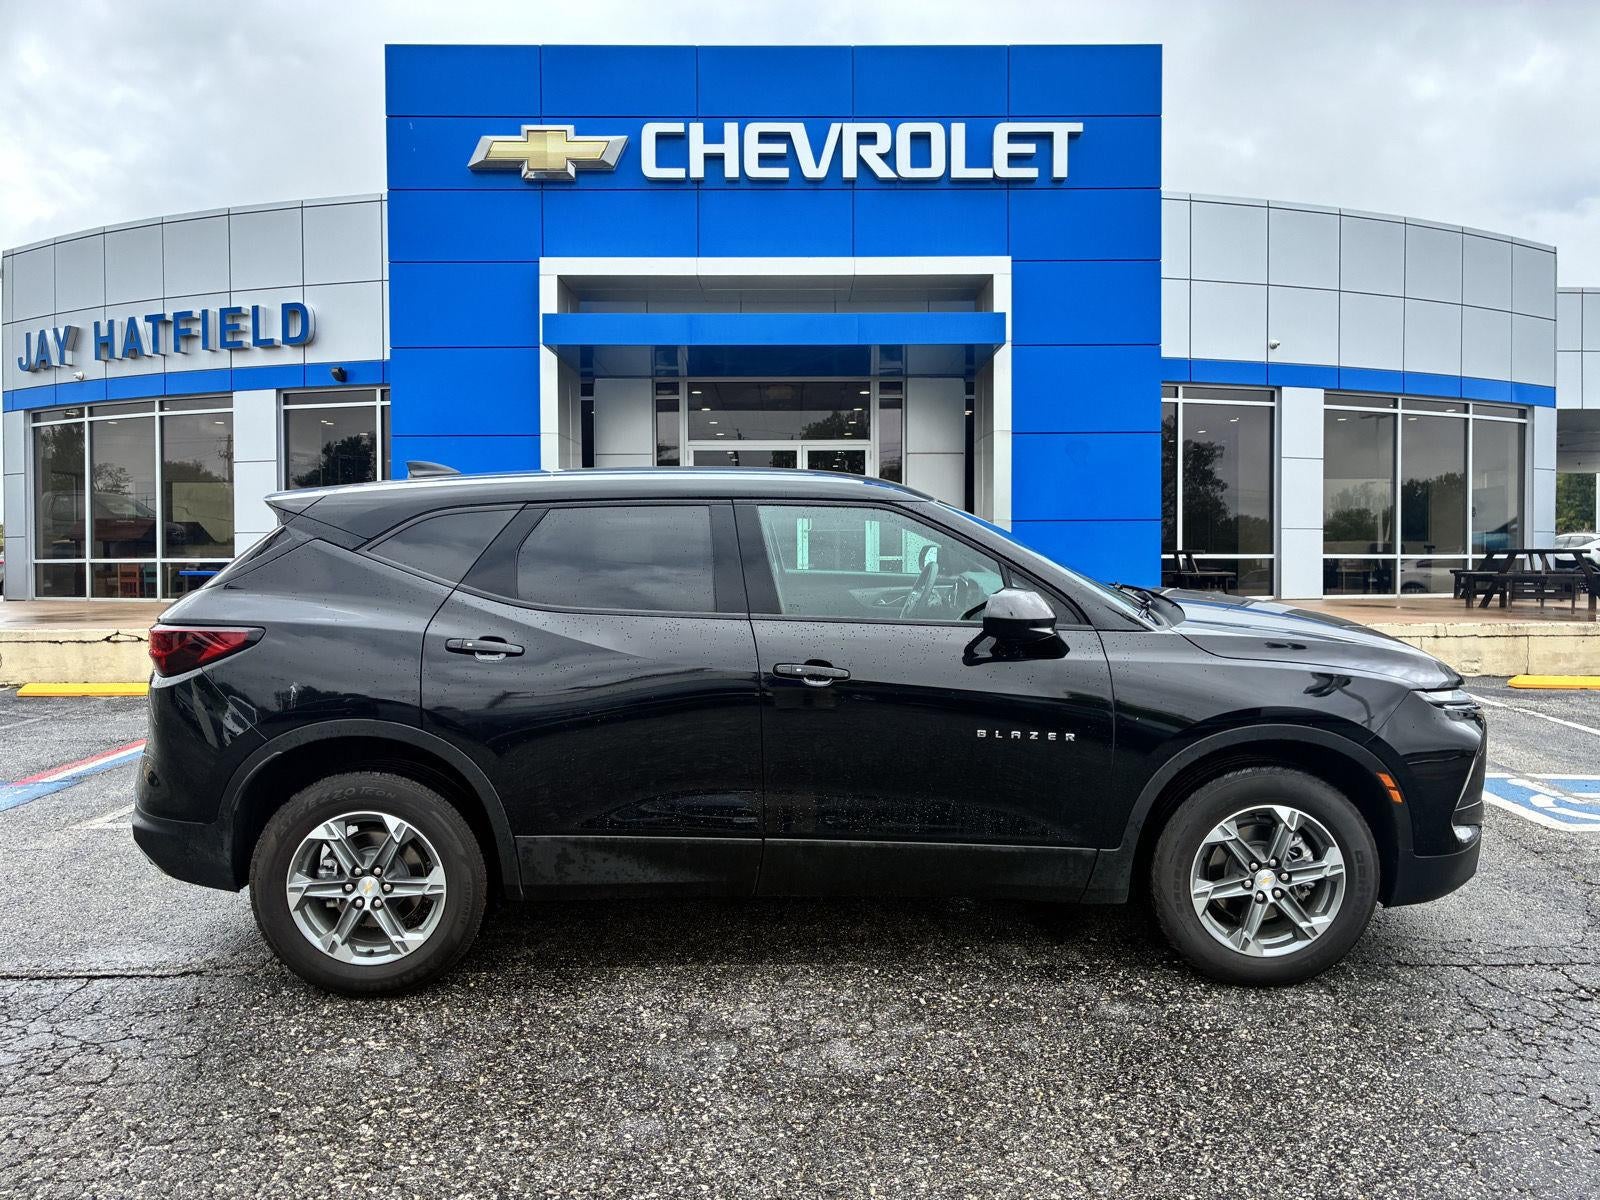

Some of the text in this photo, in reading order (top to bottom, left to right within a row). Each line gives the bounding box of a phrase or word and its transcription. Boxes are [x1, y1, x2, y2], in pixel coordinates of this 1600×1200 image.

[641, 121, 1084, 182] CHEVROLET
[18, 302, 315, 373] JAY HATFIELD
[976, 729, 1076, 742] BLAZER
